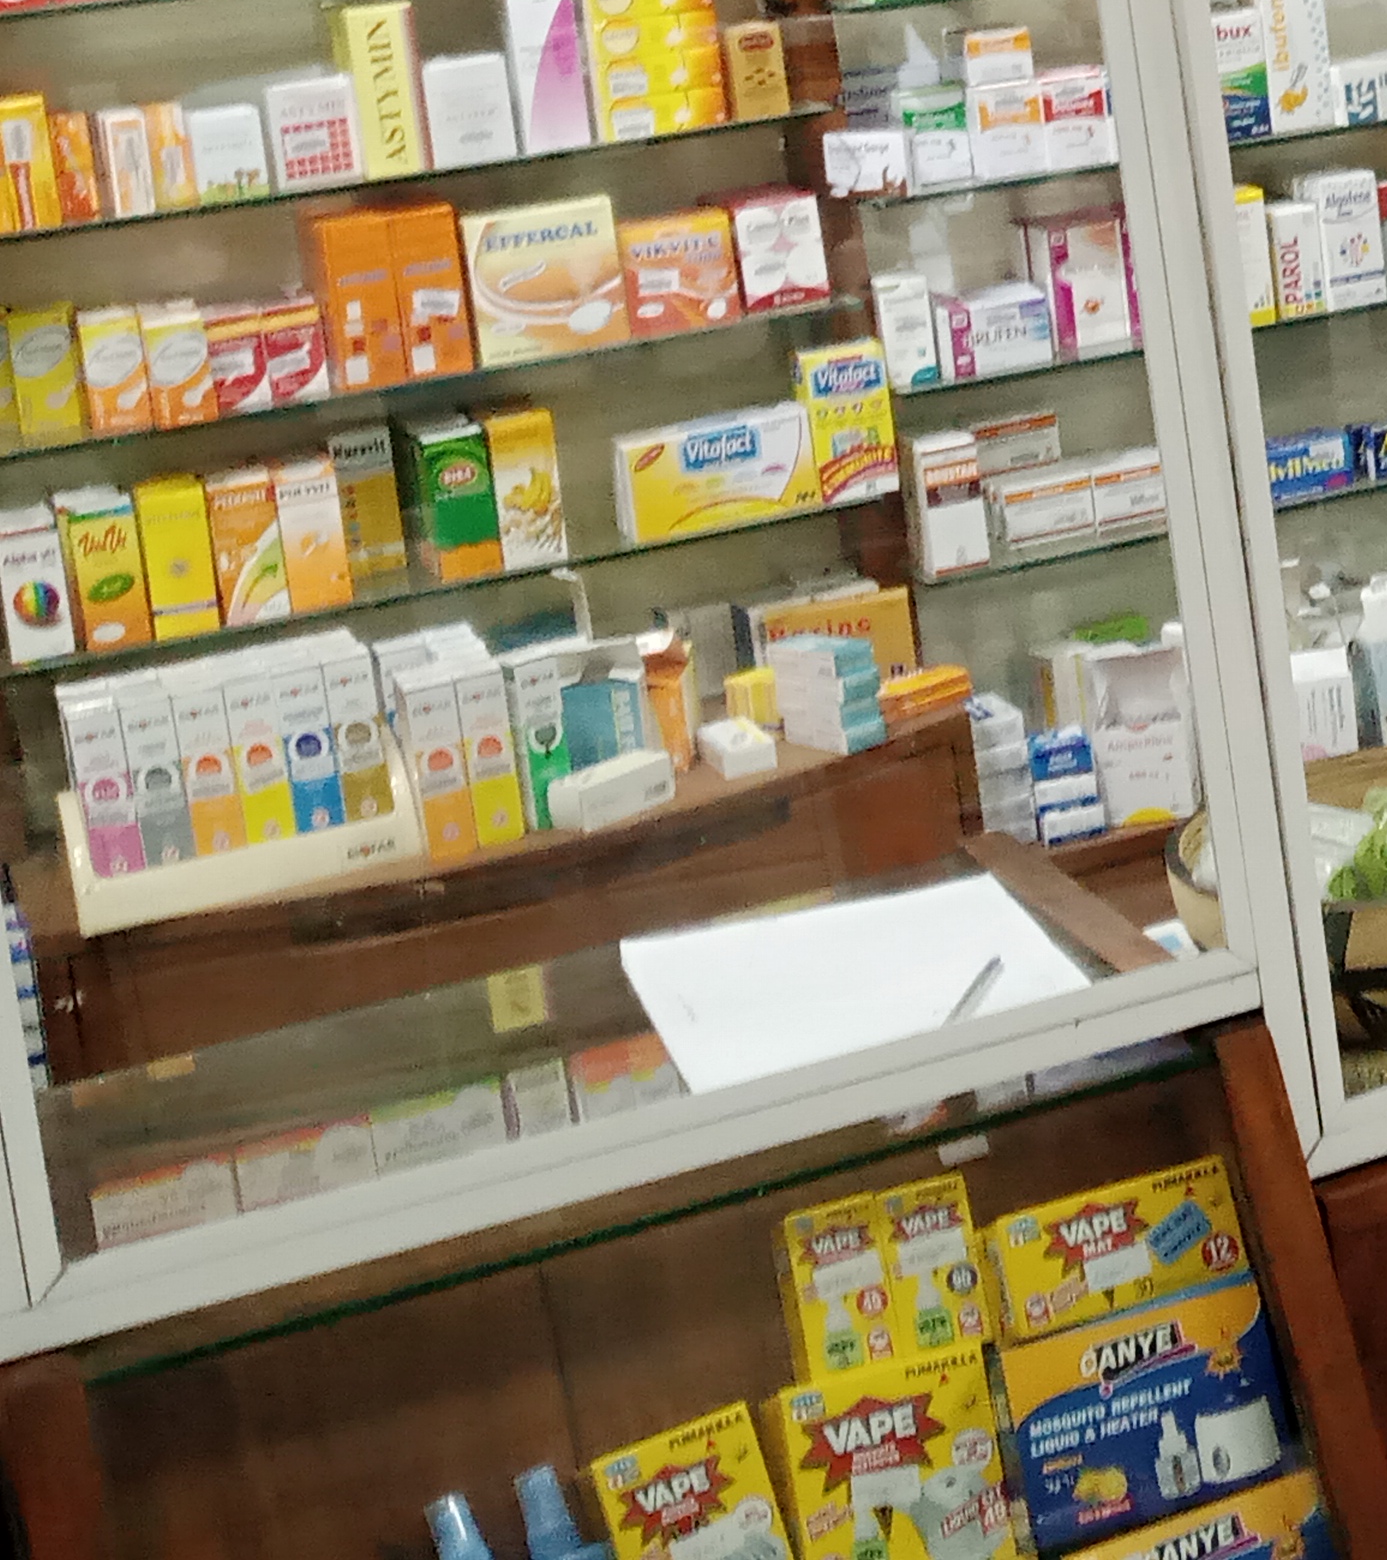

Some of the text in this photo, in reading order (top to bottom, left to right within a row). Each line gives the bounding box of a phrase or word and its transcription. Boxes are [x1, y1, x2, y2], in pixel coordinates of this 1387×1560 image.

[486, 221, 598, 252] EFFERCAL
[684, 432, 752, 465] Vitafact
[902, 1209, 951, 1235] VAPE
[1059, 1206, 1127, 1247] VAPE
[811, 1229, 862, 1256] VAPE
[1206, 1236, 1236, 1266] 12
[1029, 1377, 1194, 1440] MOSQUITO REPELLENT
[822, 1403, 917, 1456] VAPE
[1030, 1433, 1080, 1459] LIQUID
[1100, 1408, 1160, 1439] HEATER
[635, 1463, 712, 1514] VAPE
